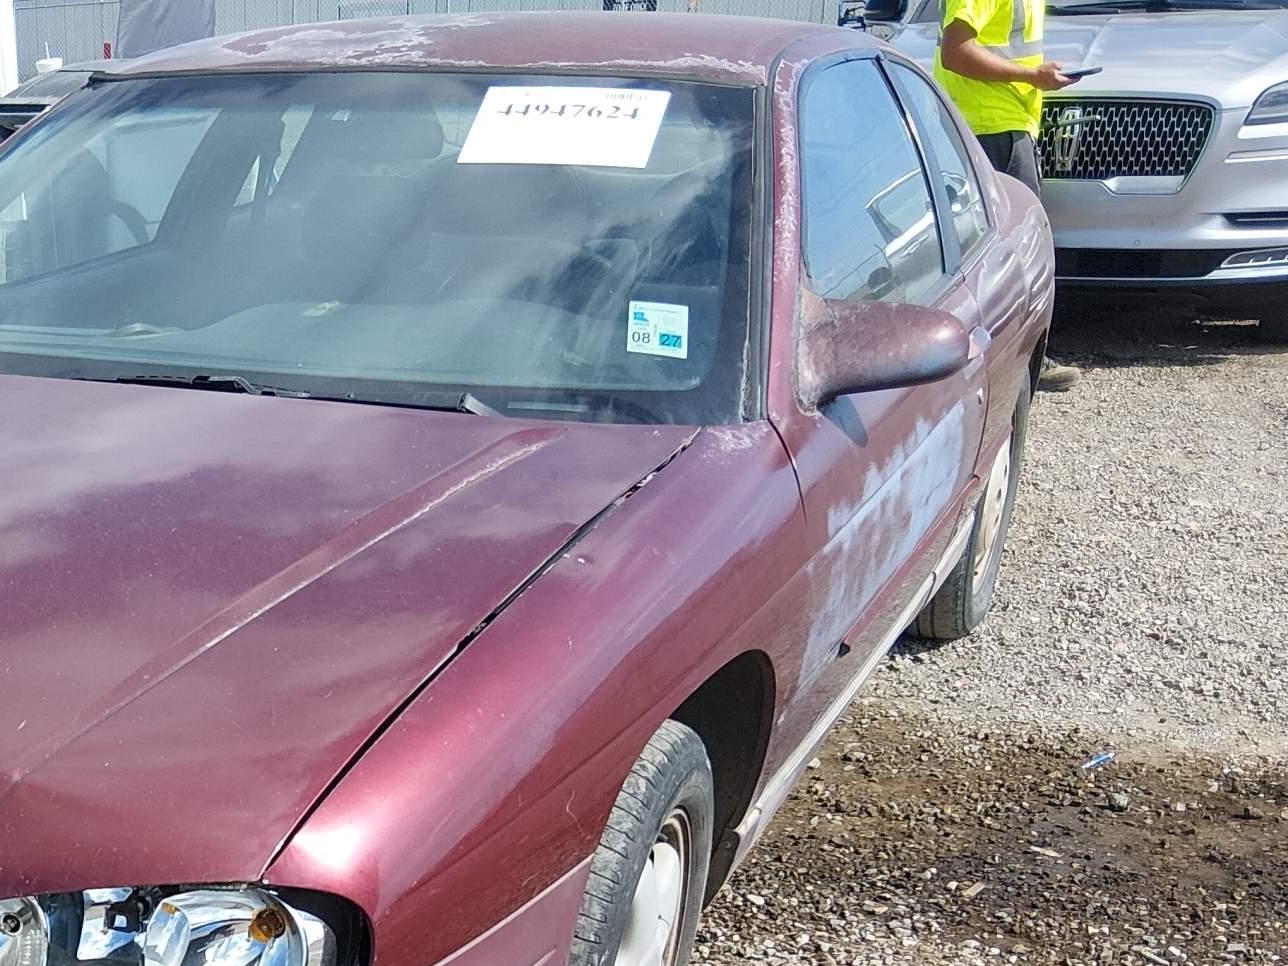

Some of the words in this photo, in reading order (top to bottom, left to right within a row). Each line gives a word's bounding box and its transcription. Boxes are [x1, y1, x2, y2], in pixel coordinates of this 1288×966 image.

[497, 103, 639, 120] 44947624
[631, 331, 651, 344] 08
[660, 333, 682, 349] 27
